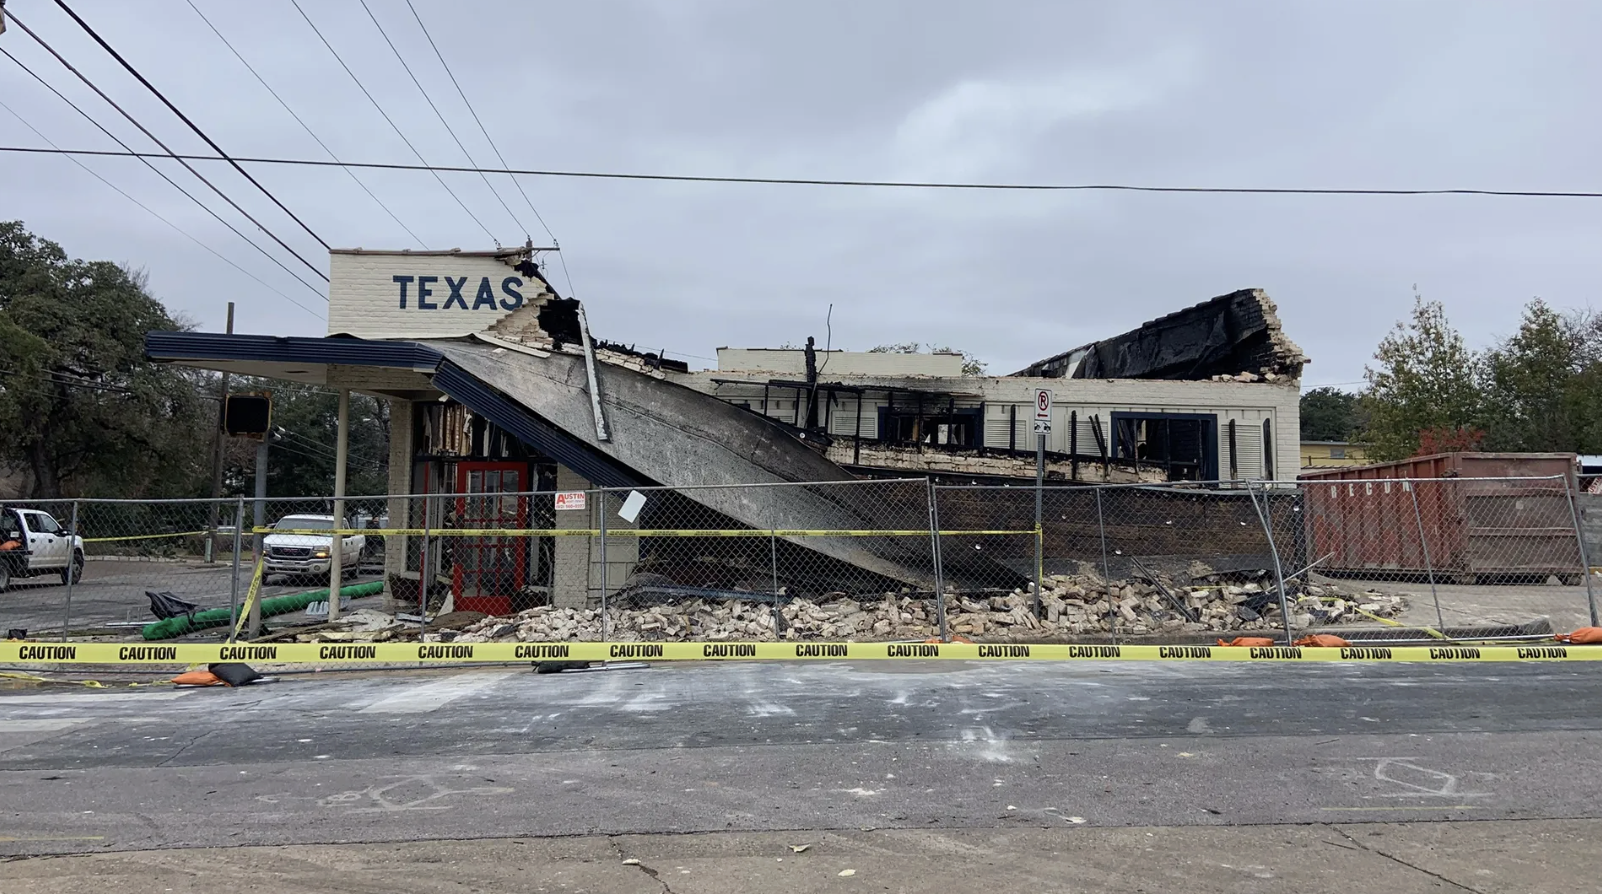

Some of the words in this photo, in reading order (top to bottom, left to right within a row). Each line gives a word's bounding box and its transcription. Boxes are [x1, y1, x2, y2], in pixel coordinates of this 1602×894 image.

[393, 275, 524, 312] TEXAS
[557, 493, 585, 504] AUSTIN
[19, 645, 76, 660] CAUTION
[119, 646, 176, 660] CAUTION
[220, 646, 276, 660] CAUTION
[320, 645, 376, 659] CAUTION
[418, 645, 473, 659] CAUTION
[515, 645, 570, 658] CAUTION
[610, 644, 663, 657] CAUTION
[704, 644, 756, 657] CAUTION
[796, 644, 848, 657] CAUTION
[888, 644, 939, 657] CAUTION
[979, 645, 1029, 657] CAUTION
[1069, 646, 1120, 658] CAUTION
[1160, 646, 1211, 658] CAUTION
[1250, 647, 1302, 659] CAUTION
[1340, 647, 1392, 659] CAUTION
[1430, 648, 1481, 659] CAUTION
[1517, 647, 1567, 658] CAUTION
